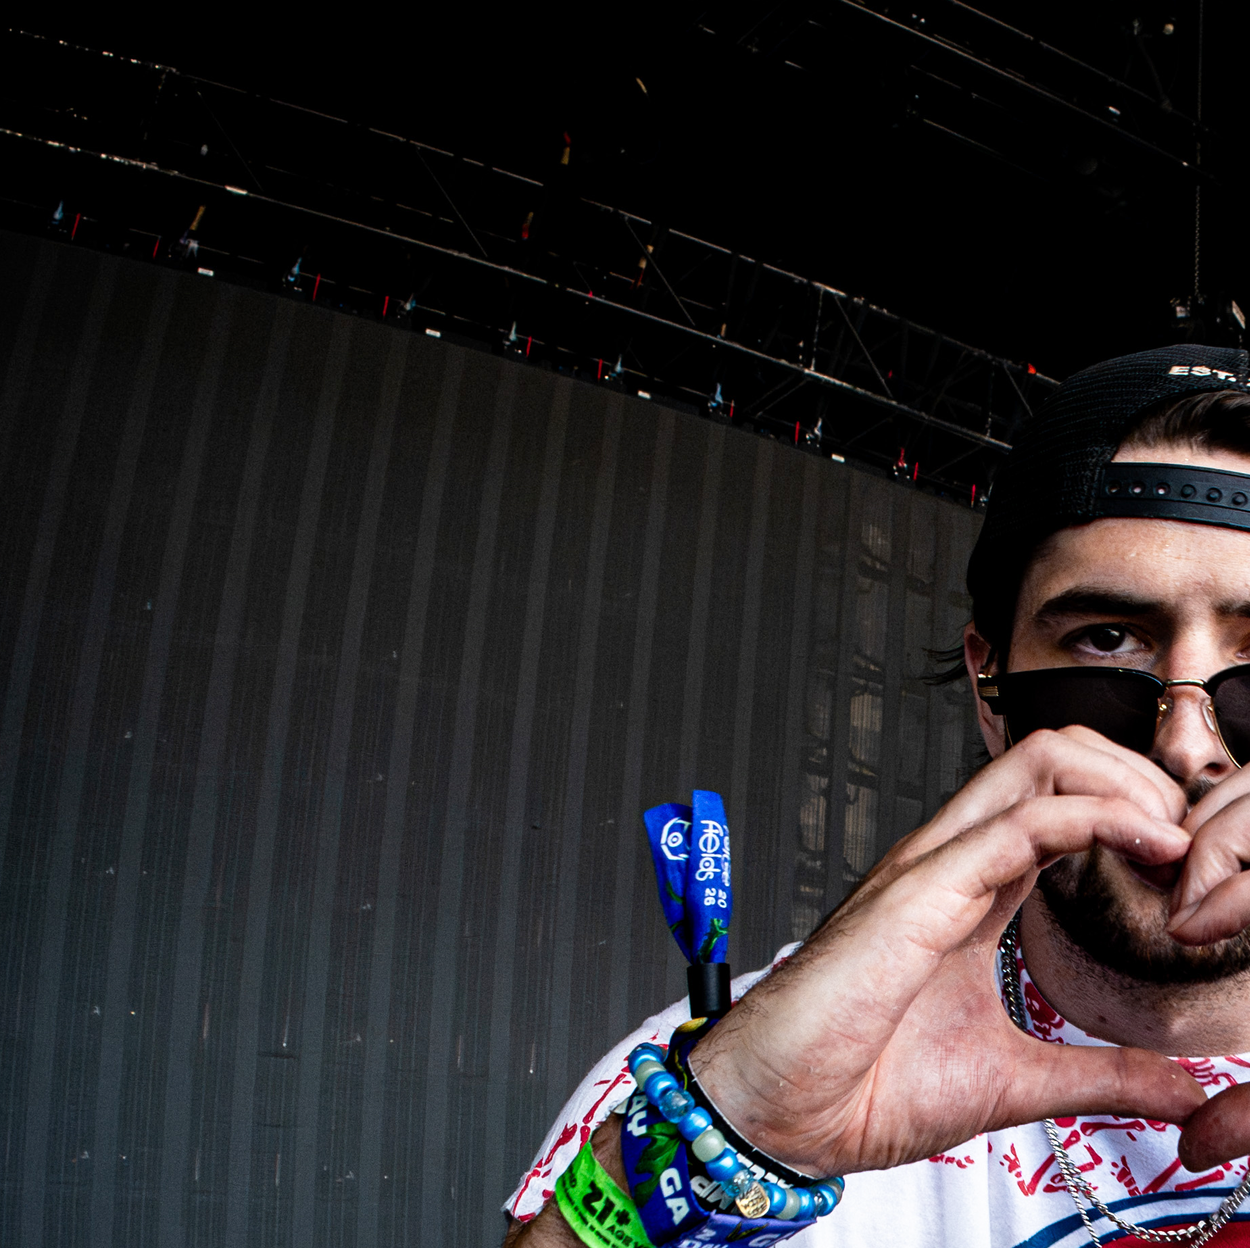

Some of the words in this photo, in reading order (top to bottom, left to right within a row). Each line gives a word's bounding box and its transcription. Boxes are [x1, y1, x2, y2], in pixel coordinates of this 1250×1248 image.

[1168, 366, 1237, 382] EST.
[627, 1092, 649, 1137] AY
[659, 1167, 691, 1226] GA
[605, 1224, 634, 1248] AGE
